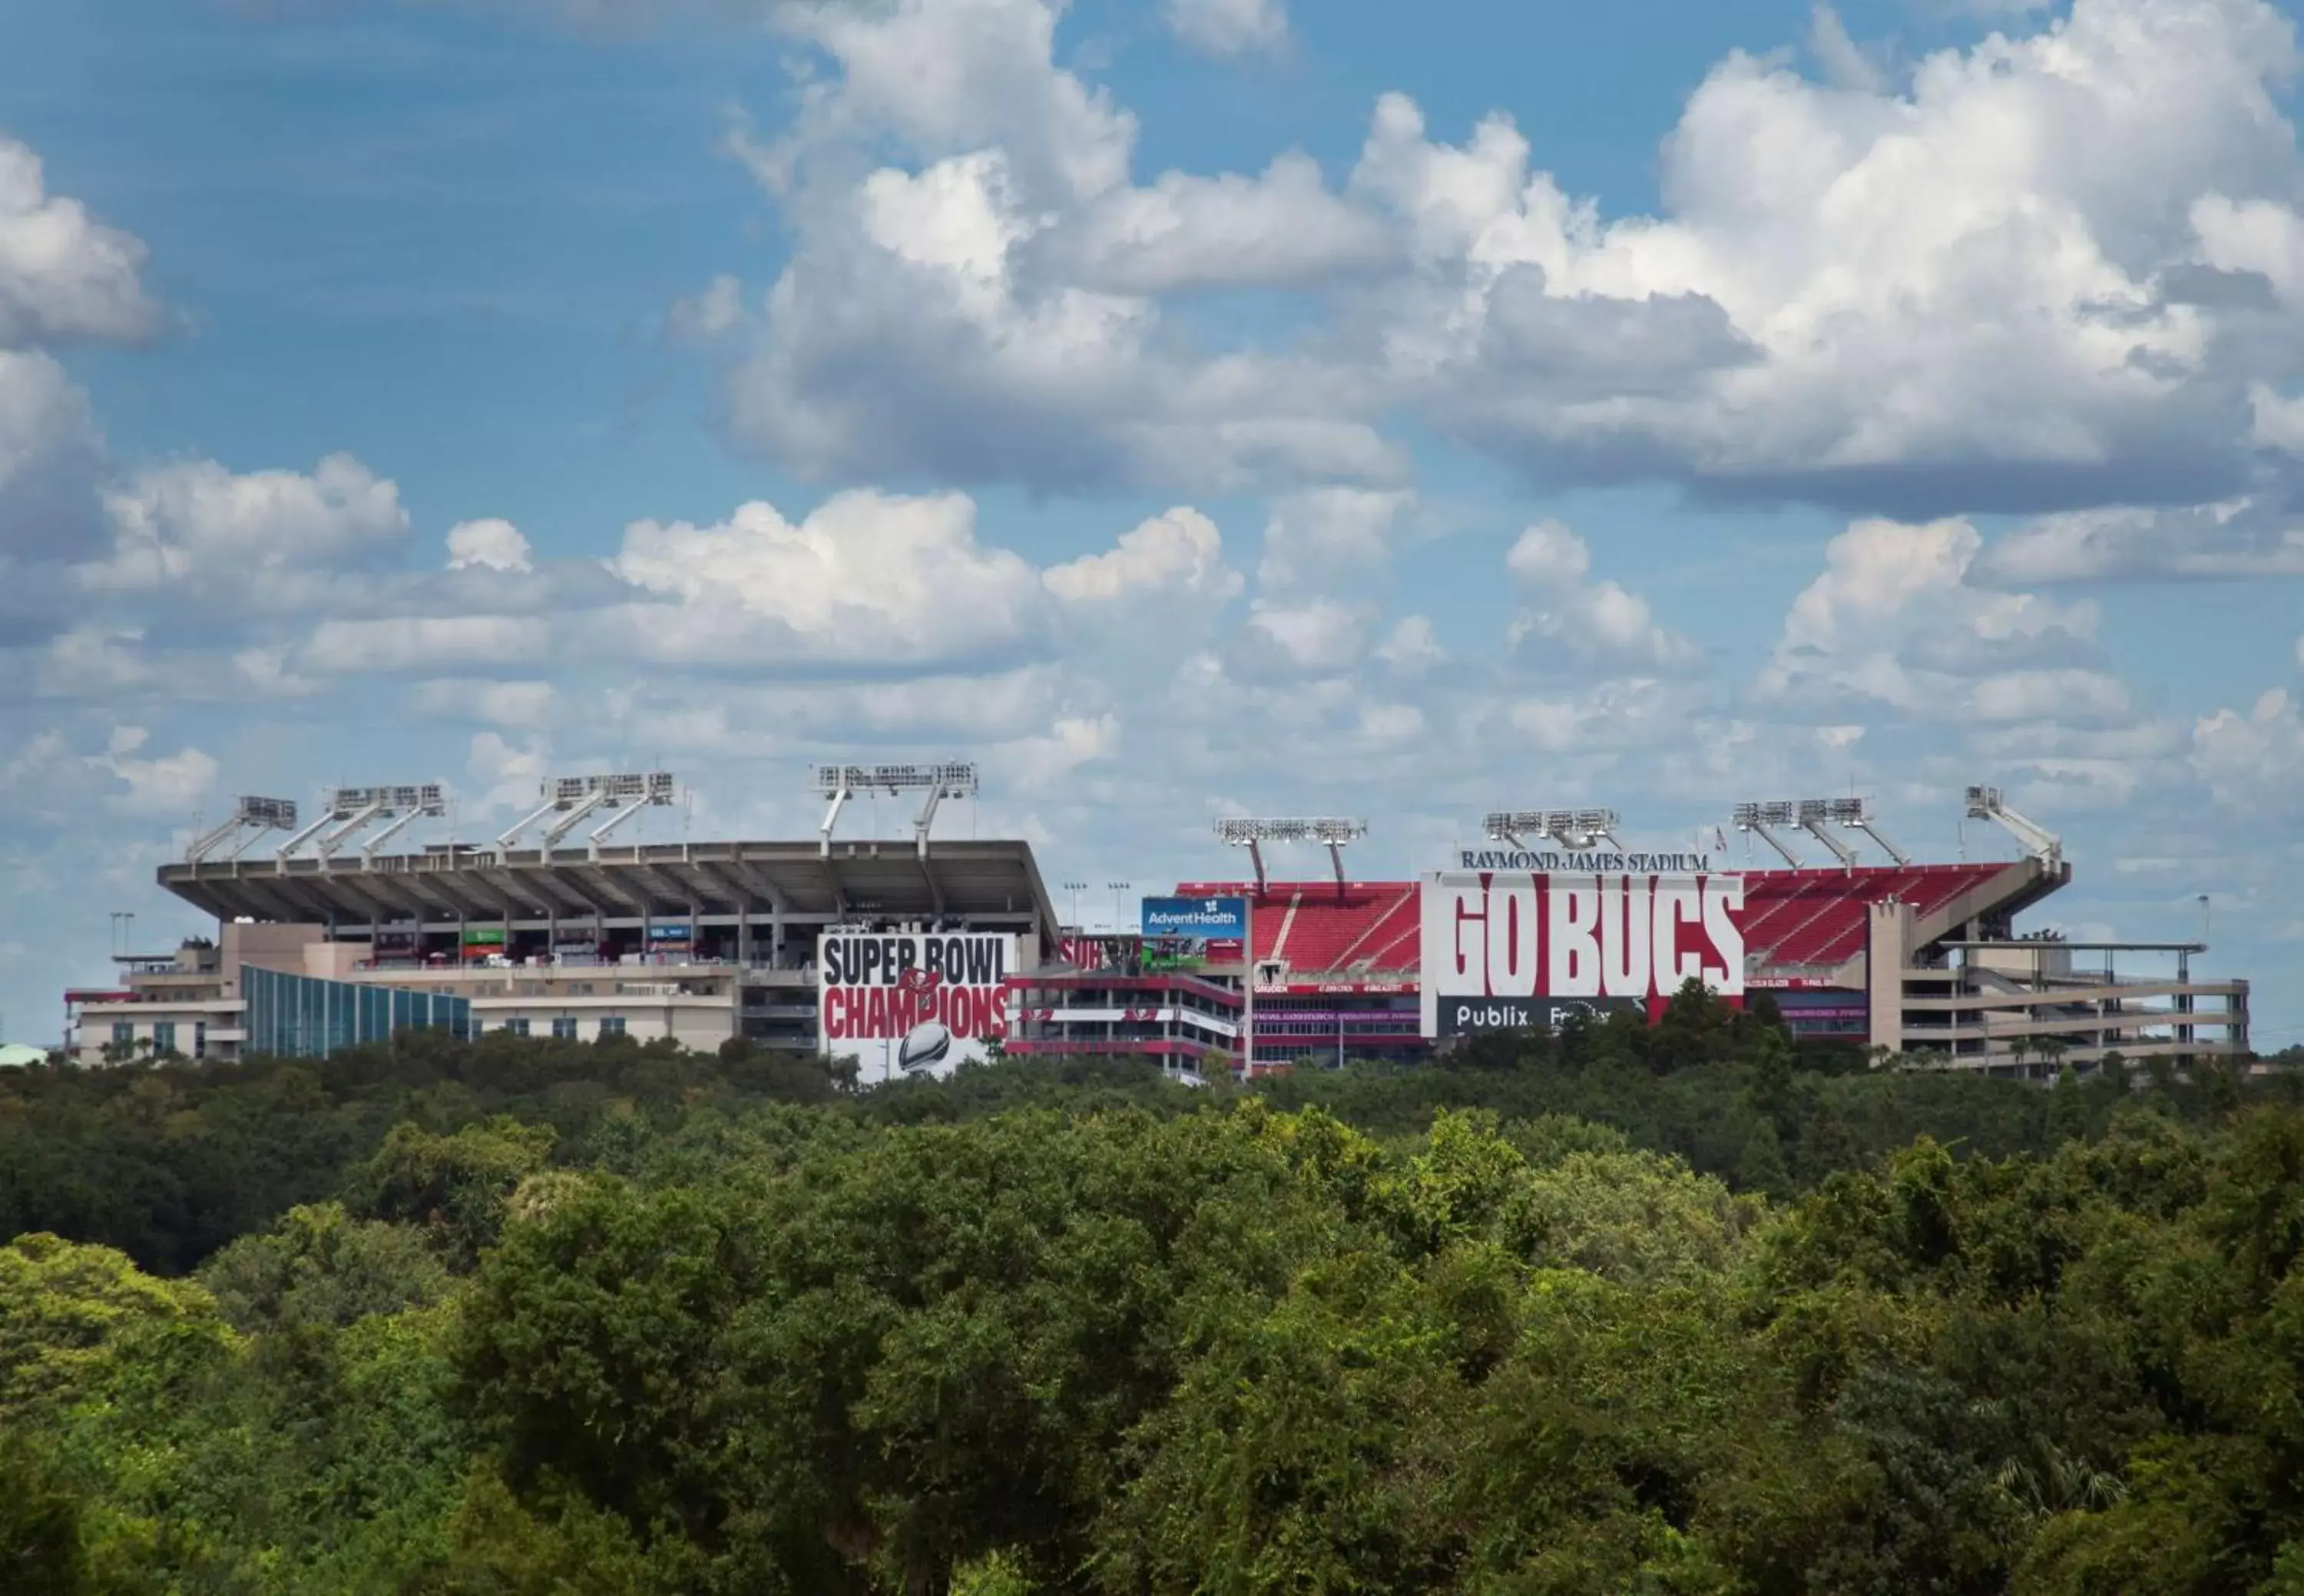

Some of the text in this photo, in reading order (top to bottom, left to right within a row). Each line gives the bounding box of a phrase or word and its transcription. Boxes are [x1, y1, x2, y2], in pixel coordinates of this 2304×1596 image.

[1462, 850, 1709, 873] RAYMOND JAMES STADIUM
[1436, 873, 1744, 996] GO BUCS
[824, 937, 1004, 985] SUPER BOWL
[824, 986, 1008, 1039] CHAMPIONS
[1457, 1005, 1528, 1026] Publix
